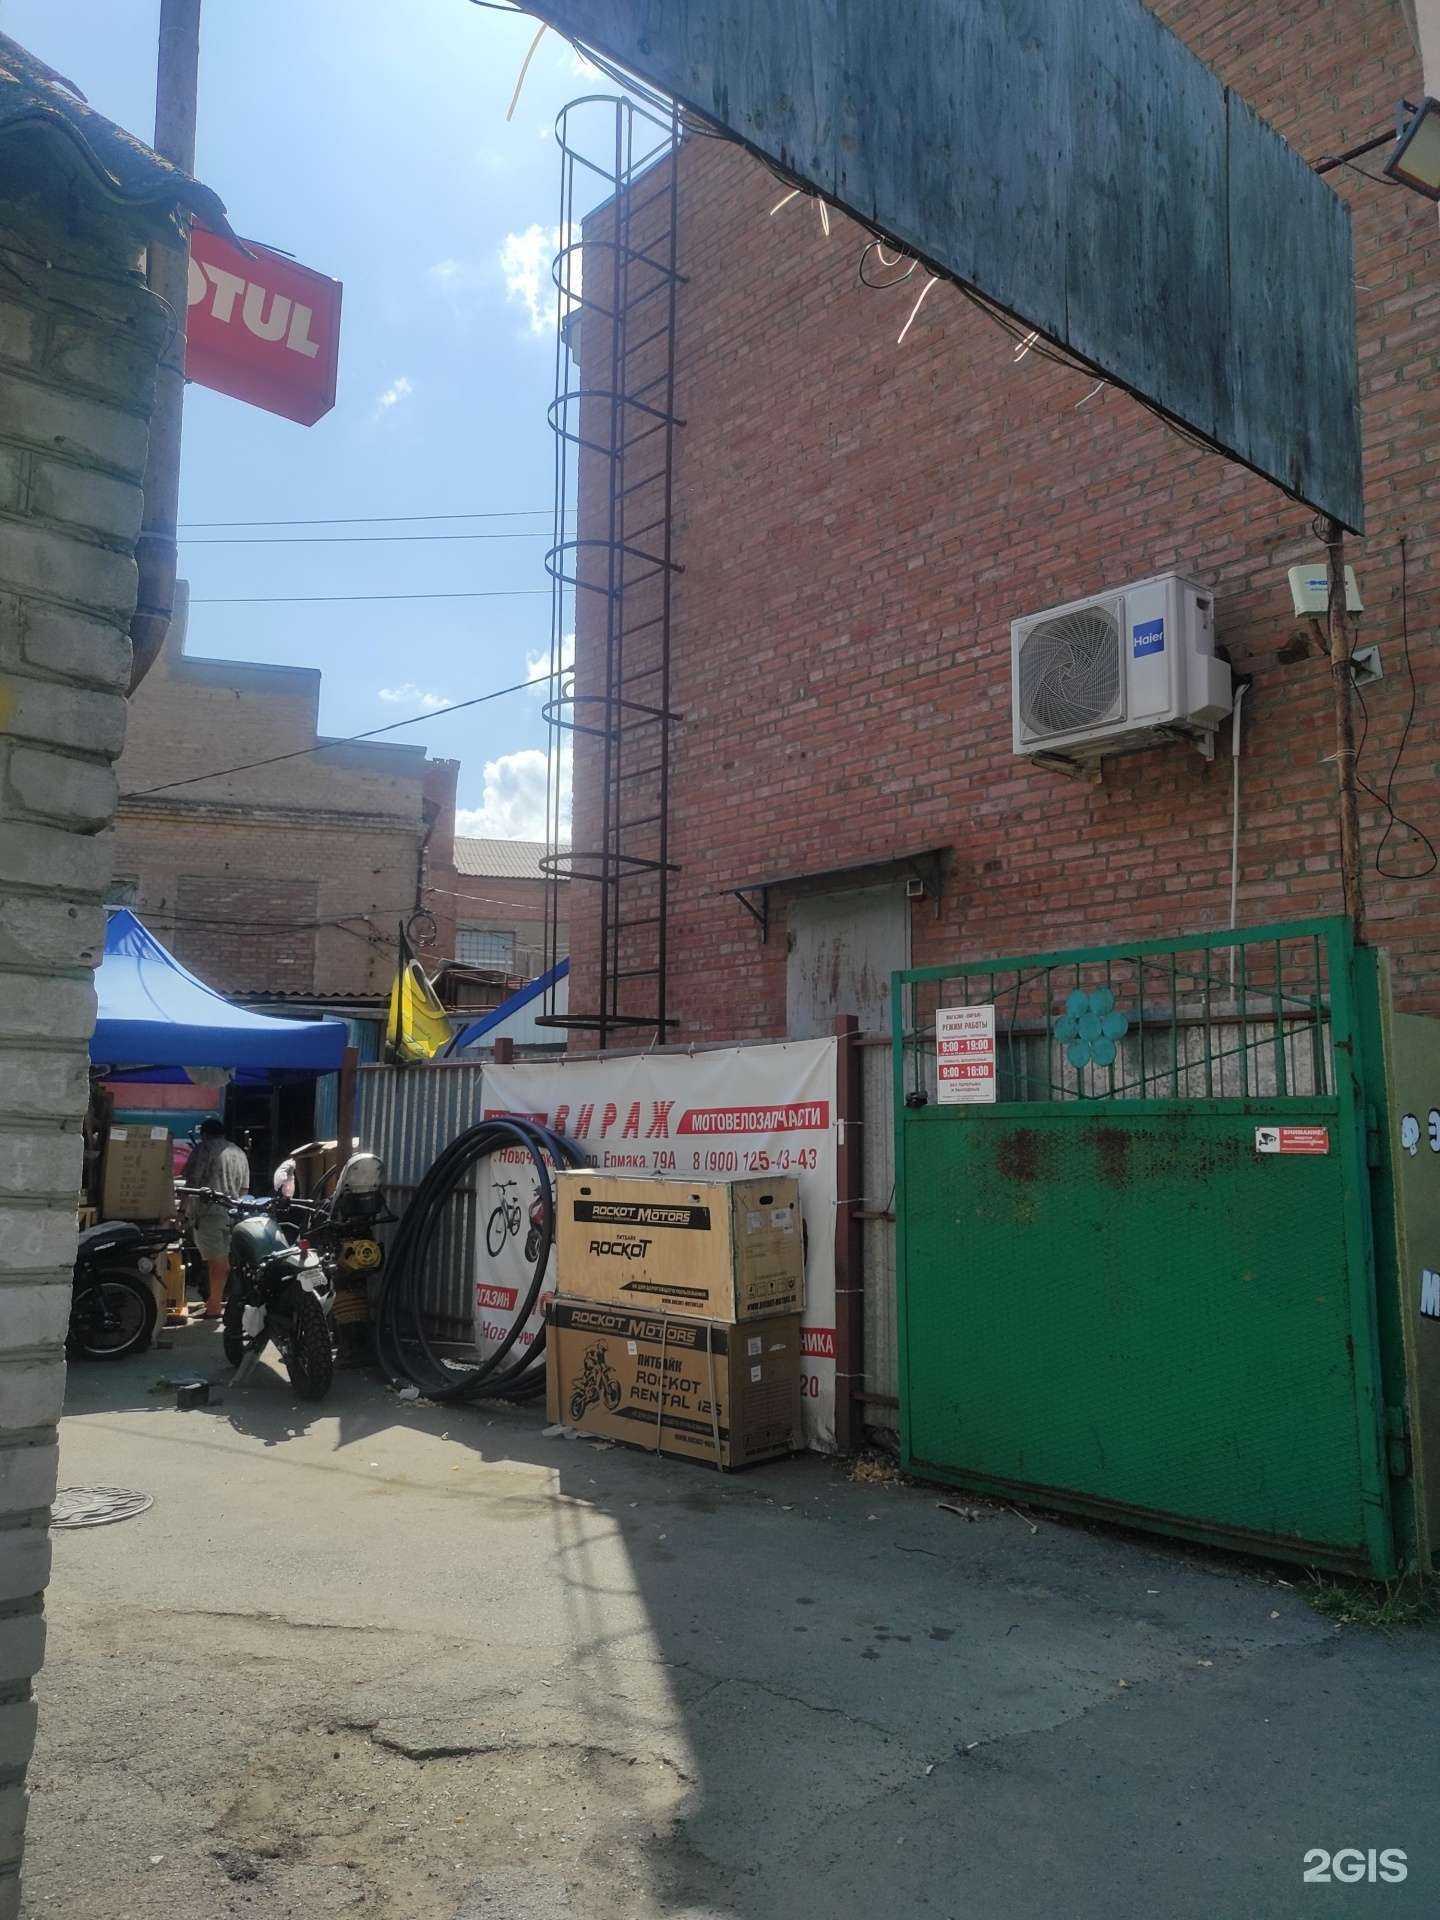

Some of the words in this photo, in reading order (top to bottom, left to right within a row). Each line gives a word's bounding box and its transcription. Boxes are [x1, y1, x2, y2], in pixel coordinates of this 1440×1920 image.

[1134, 631, 1164, 647] Haier
[964, 1019, 988, 1030] РАБОТЫ
[942, 1067, 959, 1078] 9:00
[554, 1101, 675, 1140] ВИРАЖ
[691, 1107, 821, 1131] МОТОВЕЛОЗАПЧАСТИ
[693, 1151, 700, 1171] 8
[704, 1151, 738, 1172] (900)
[592, 1205, 637, 1217] ROCKOT
[637, 1208, 691, 1224] MOTORS
[589, 1239, 653, 1260] ROCKOT
[571, 1311, 626, 1329] ROCKOT
[628, 1319, 697, 1343] MOTORS
[636, 1371, 702, 1395] ROCKOT
[630, 1387, 691, 1409] RENTAL
[697, 1400, 722, 1417] 125
